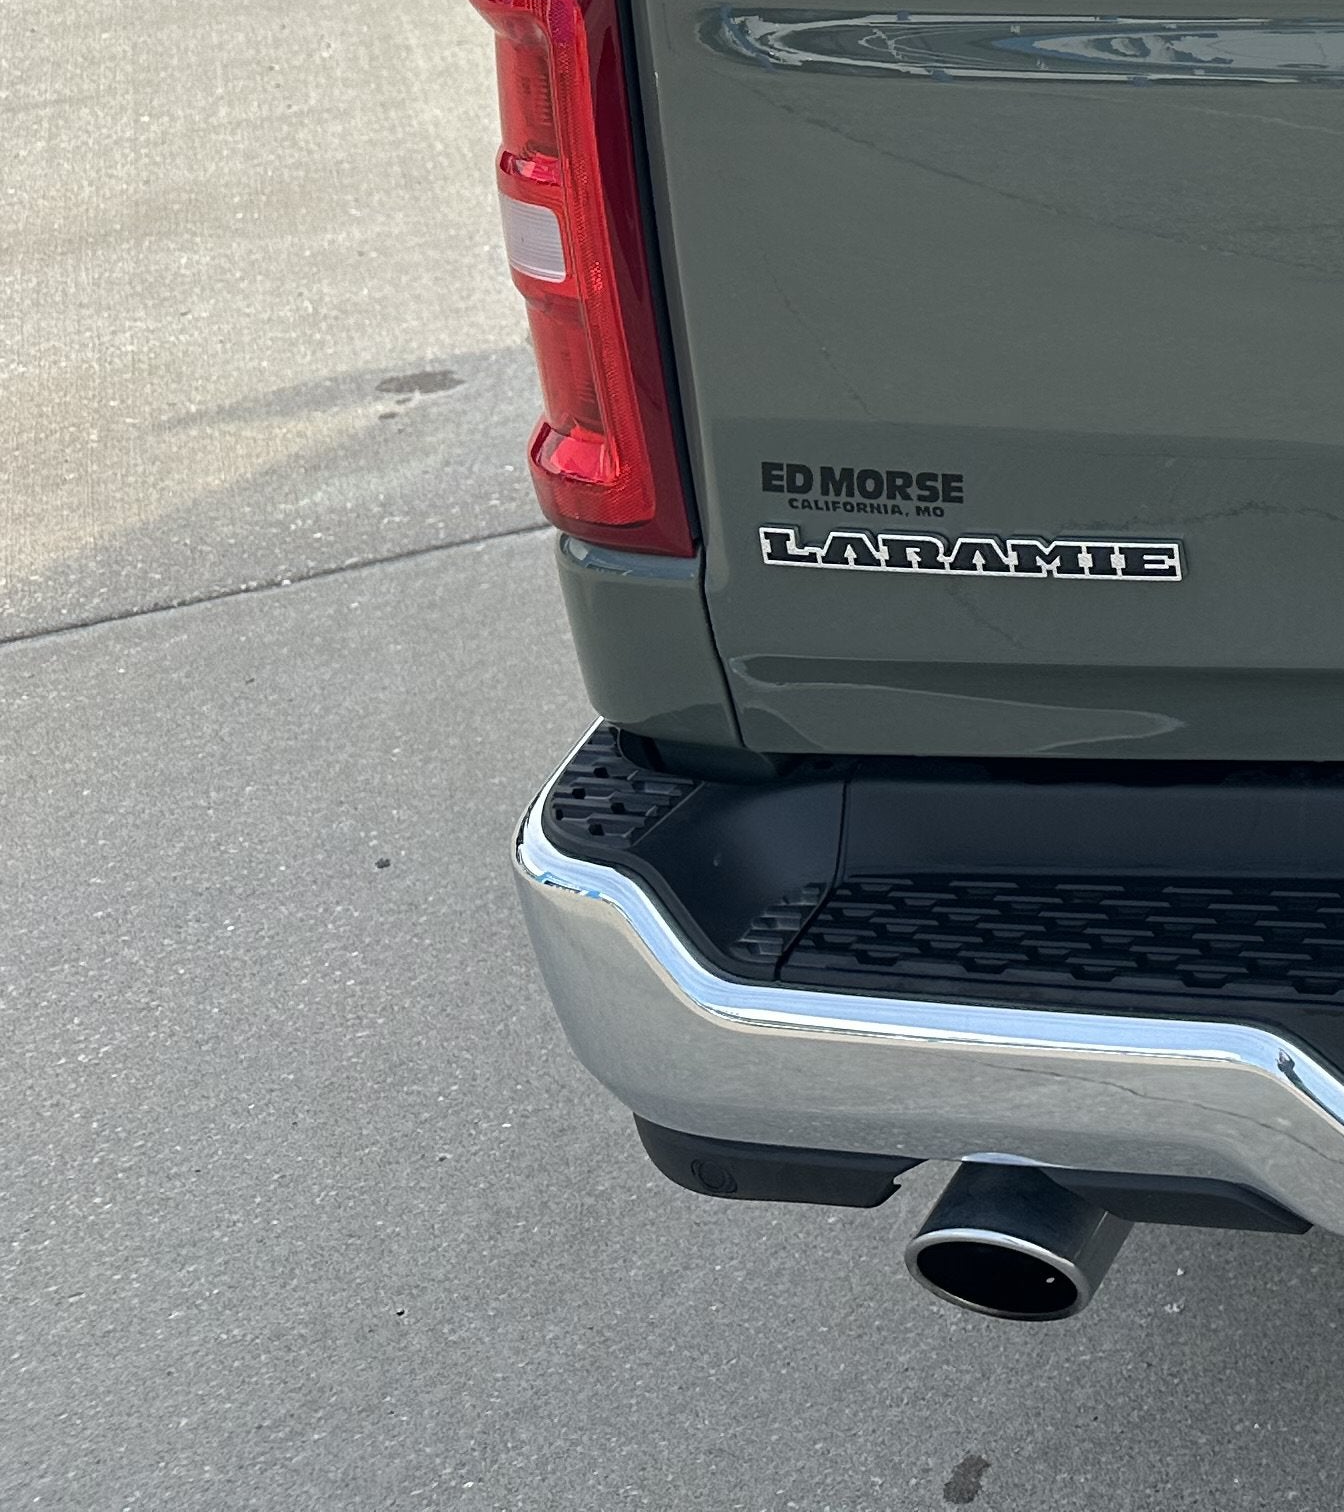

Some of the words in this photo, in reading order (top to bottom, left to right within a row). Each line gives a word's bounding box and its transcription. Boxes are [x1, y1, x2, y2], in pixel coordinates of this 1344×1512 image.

[761, 461, 813, 494] ED
[820, 466, 964, 504] MORSE
[788, 498, 909, 517] CALIFORNIA,
[916, 506, 945, 517] MO
[759, 526, 1183, 581] LARAMIE
